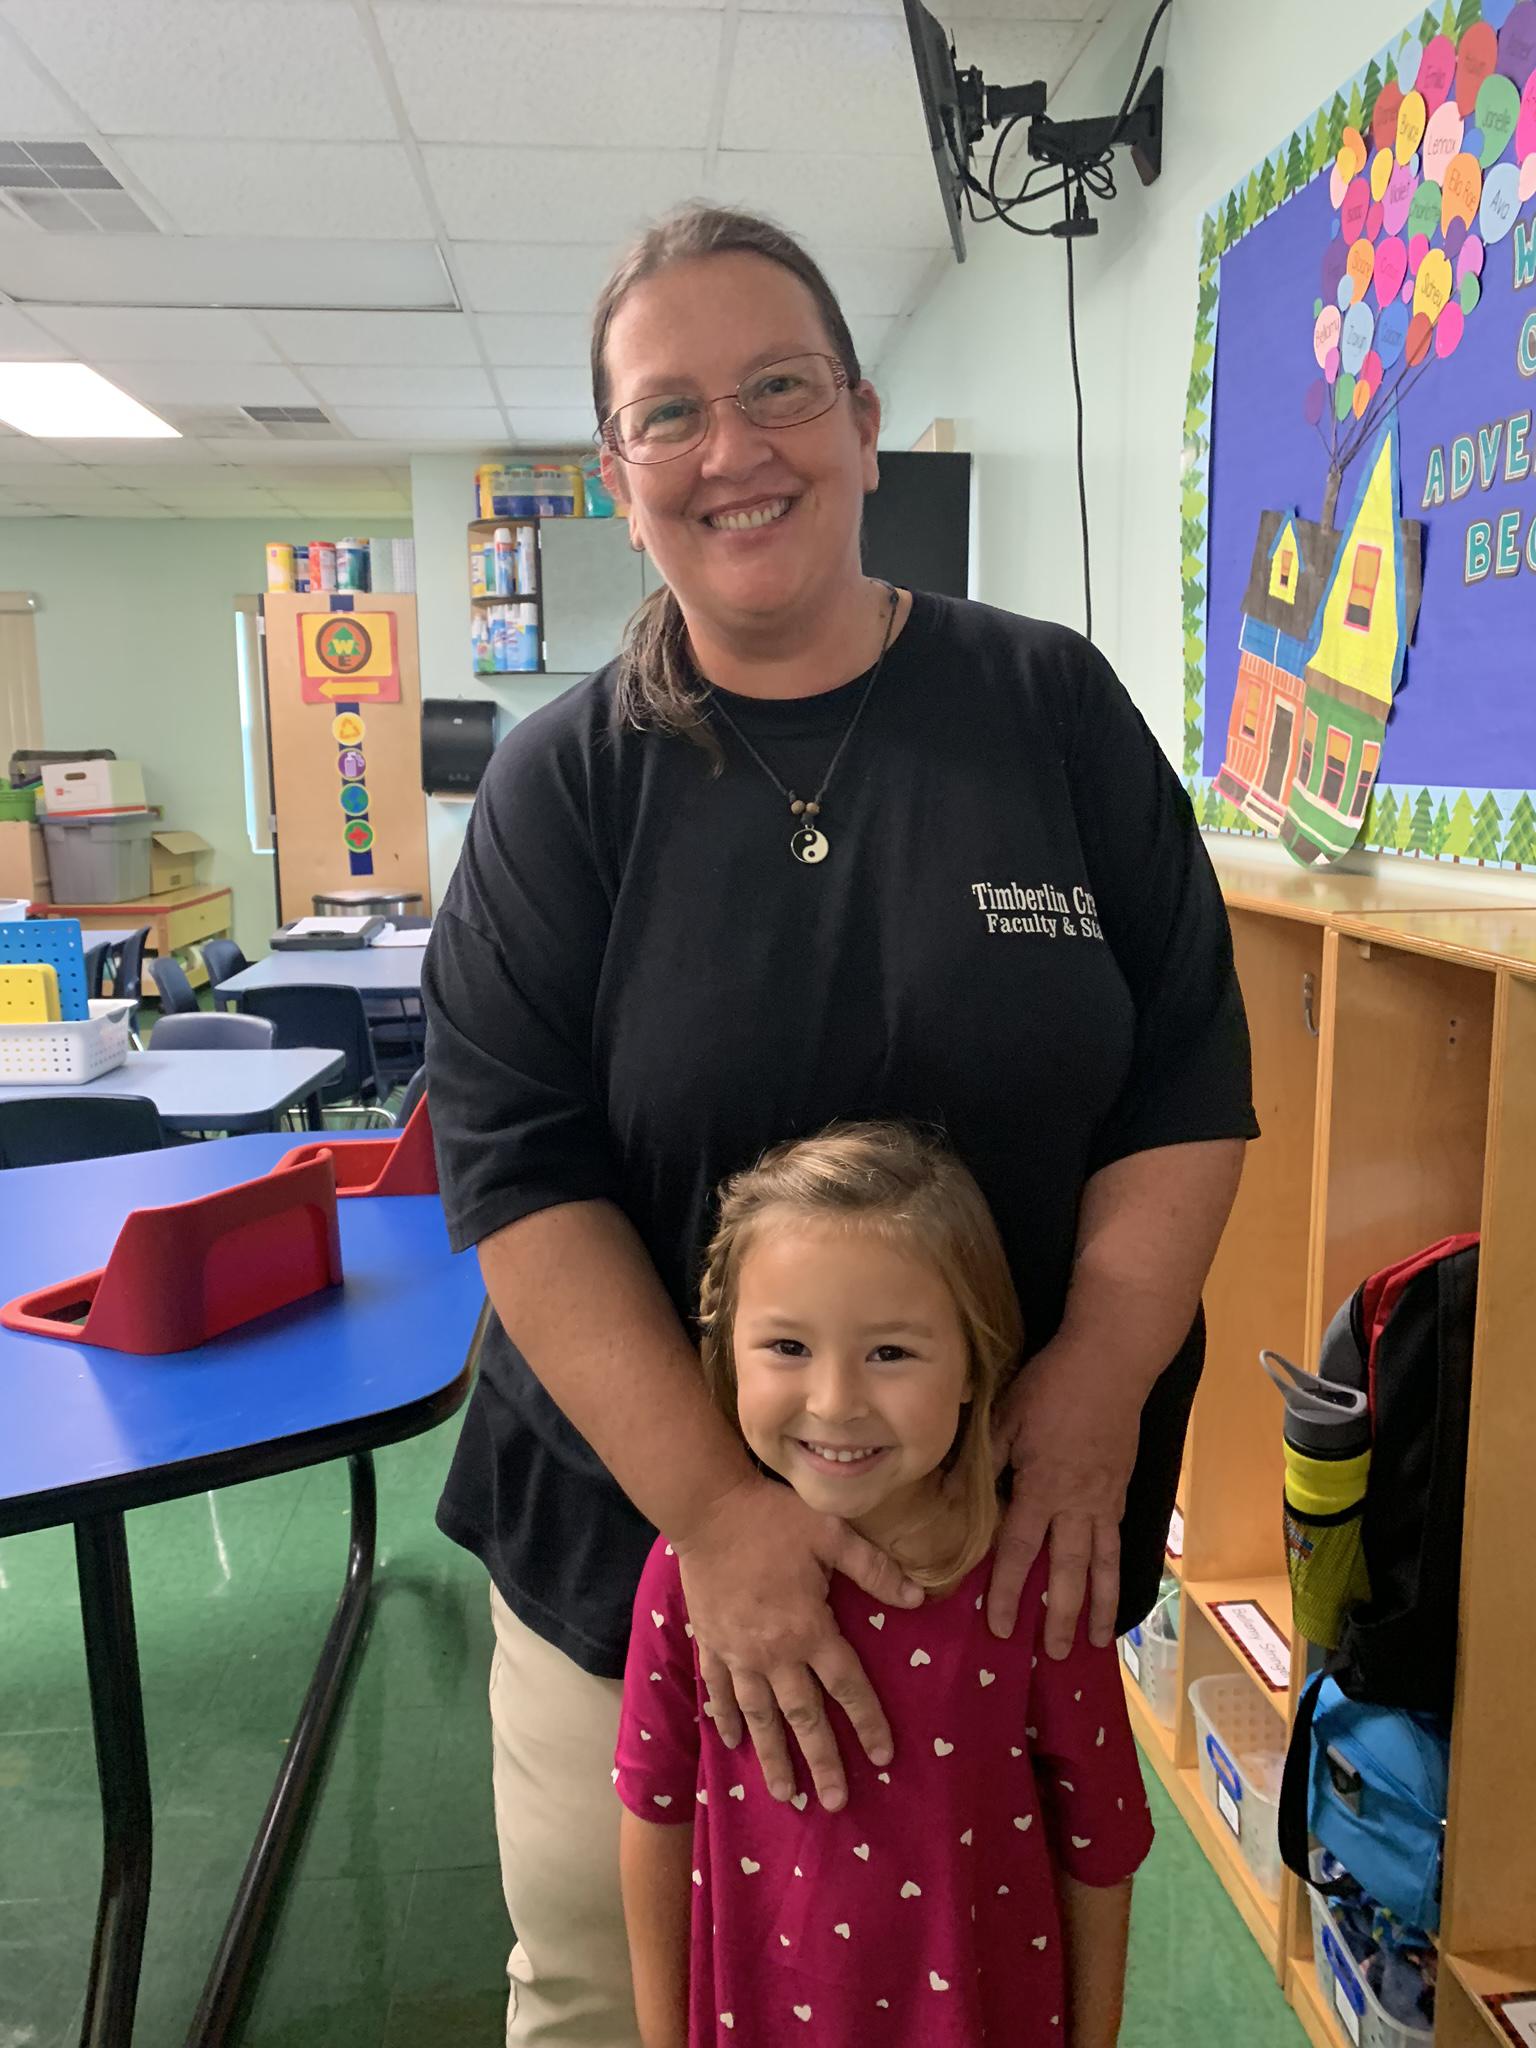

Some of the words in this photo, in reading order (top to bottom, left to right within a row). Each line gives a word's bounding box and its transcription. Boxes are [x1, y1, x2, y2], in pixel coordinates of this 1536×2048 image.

[1427, 134, 1457, 156] Lennox
[1421, 414, 1536, 508] ADVE
[971, 881, 1070, 914] Timberlin
[1072, 886, 1098, 917] Cr
[985, 913, 1057, 938] Faculty
[1062, 916, 1077, 936] &
